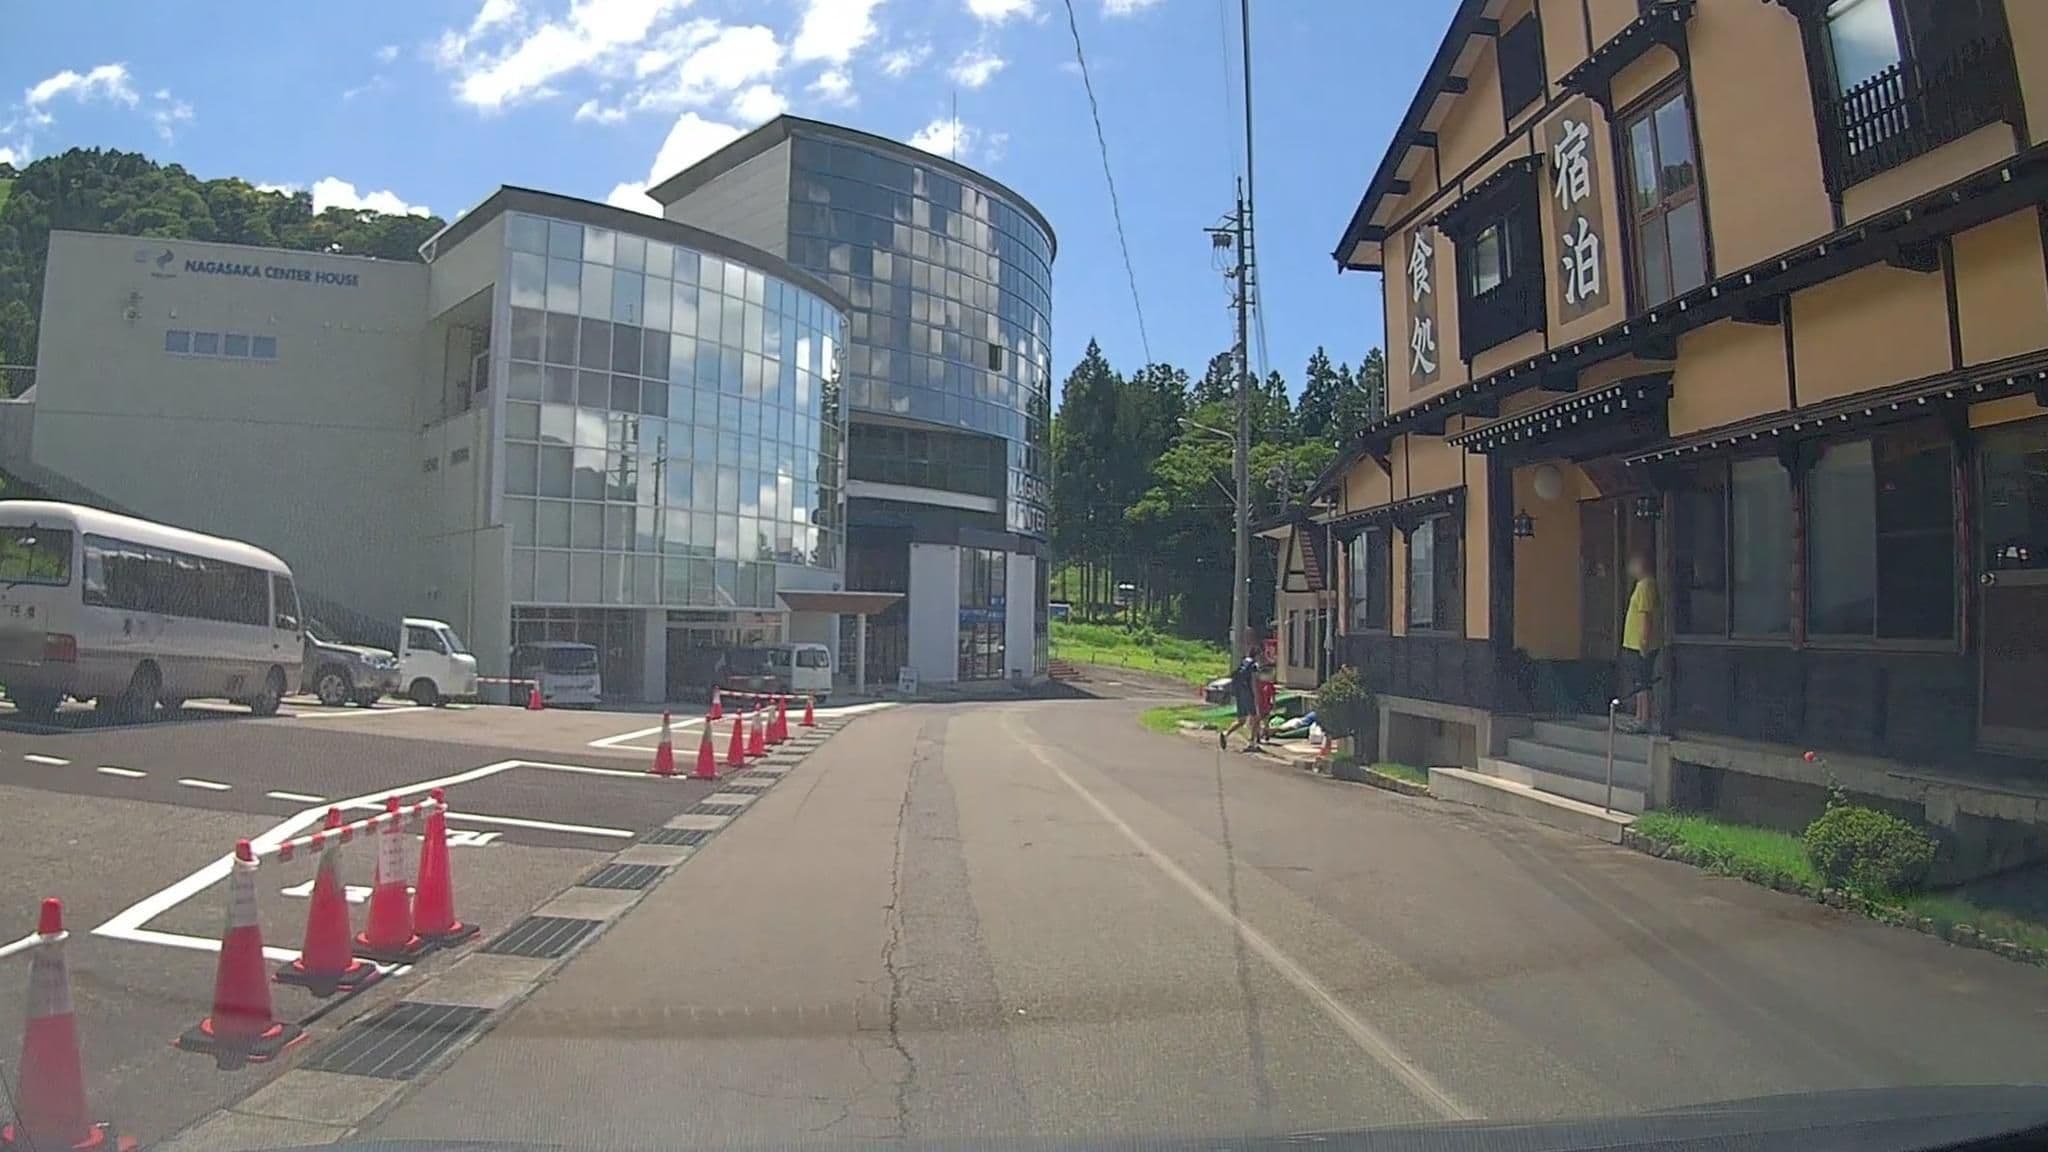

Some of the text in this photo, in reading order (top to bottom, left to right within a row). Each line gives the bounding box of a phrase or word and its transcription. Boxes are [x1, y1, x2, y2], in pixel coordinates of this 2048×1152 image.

[184, 259, 261, 278] NAGASAKA
[264, 266, 311, 282] CENTER
[314, 272, 360, 287] HOUSE
[1552, 119, 1600, 305] 宿泊
[1407, 232, 1436, 375] 食処
